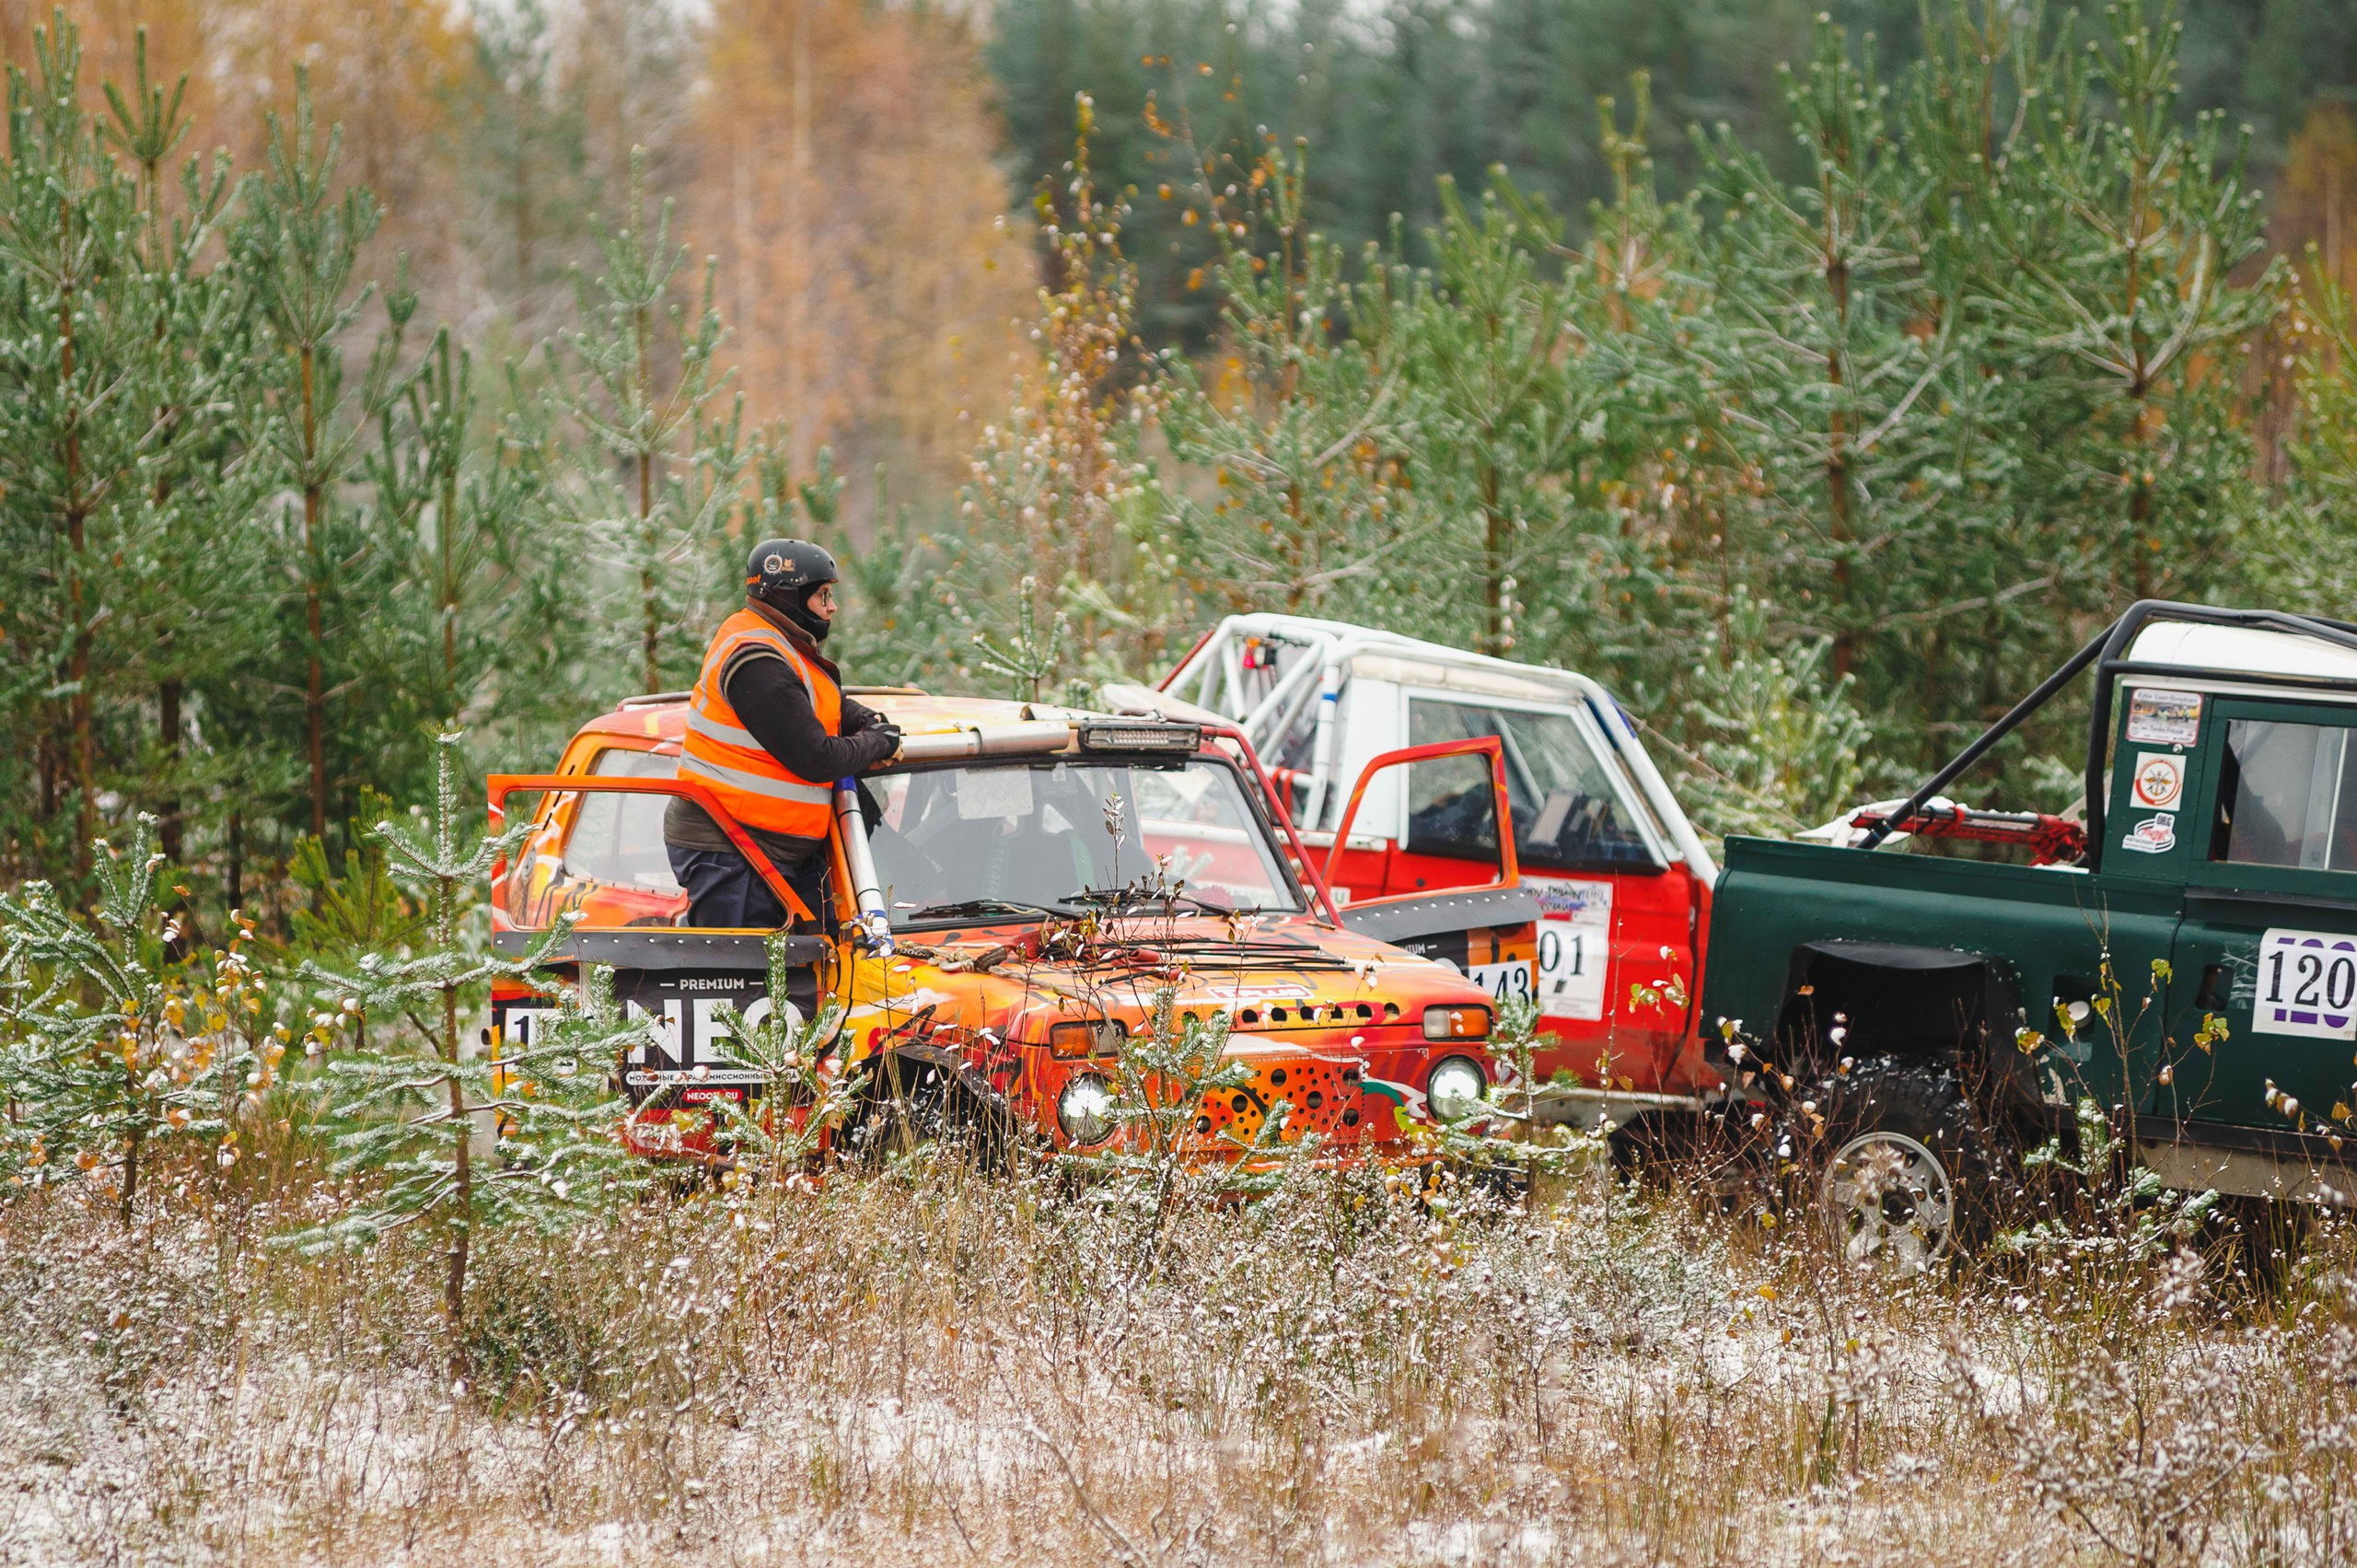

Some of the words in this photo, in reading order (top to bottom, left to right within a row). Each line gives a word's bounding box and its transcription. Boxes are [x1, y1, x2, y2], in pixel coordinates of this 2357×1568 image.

[679, 978, 745, 991] PREMIUM
[2265, 950, 2356, 1010] 120
[626, 996, 804, 1063] NEO
[629, 1074, 674, 1082] МОТНЫЕ
[683, 1072, 768, 1082] РАМИССИОННЫ
